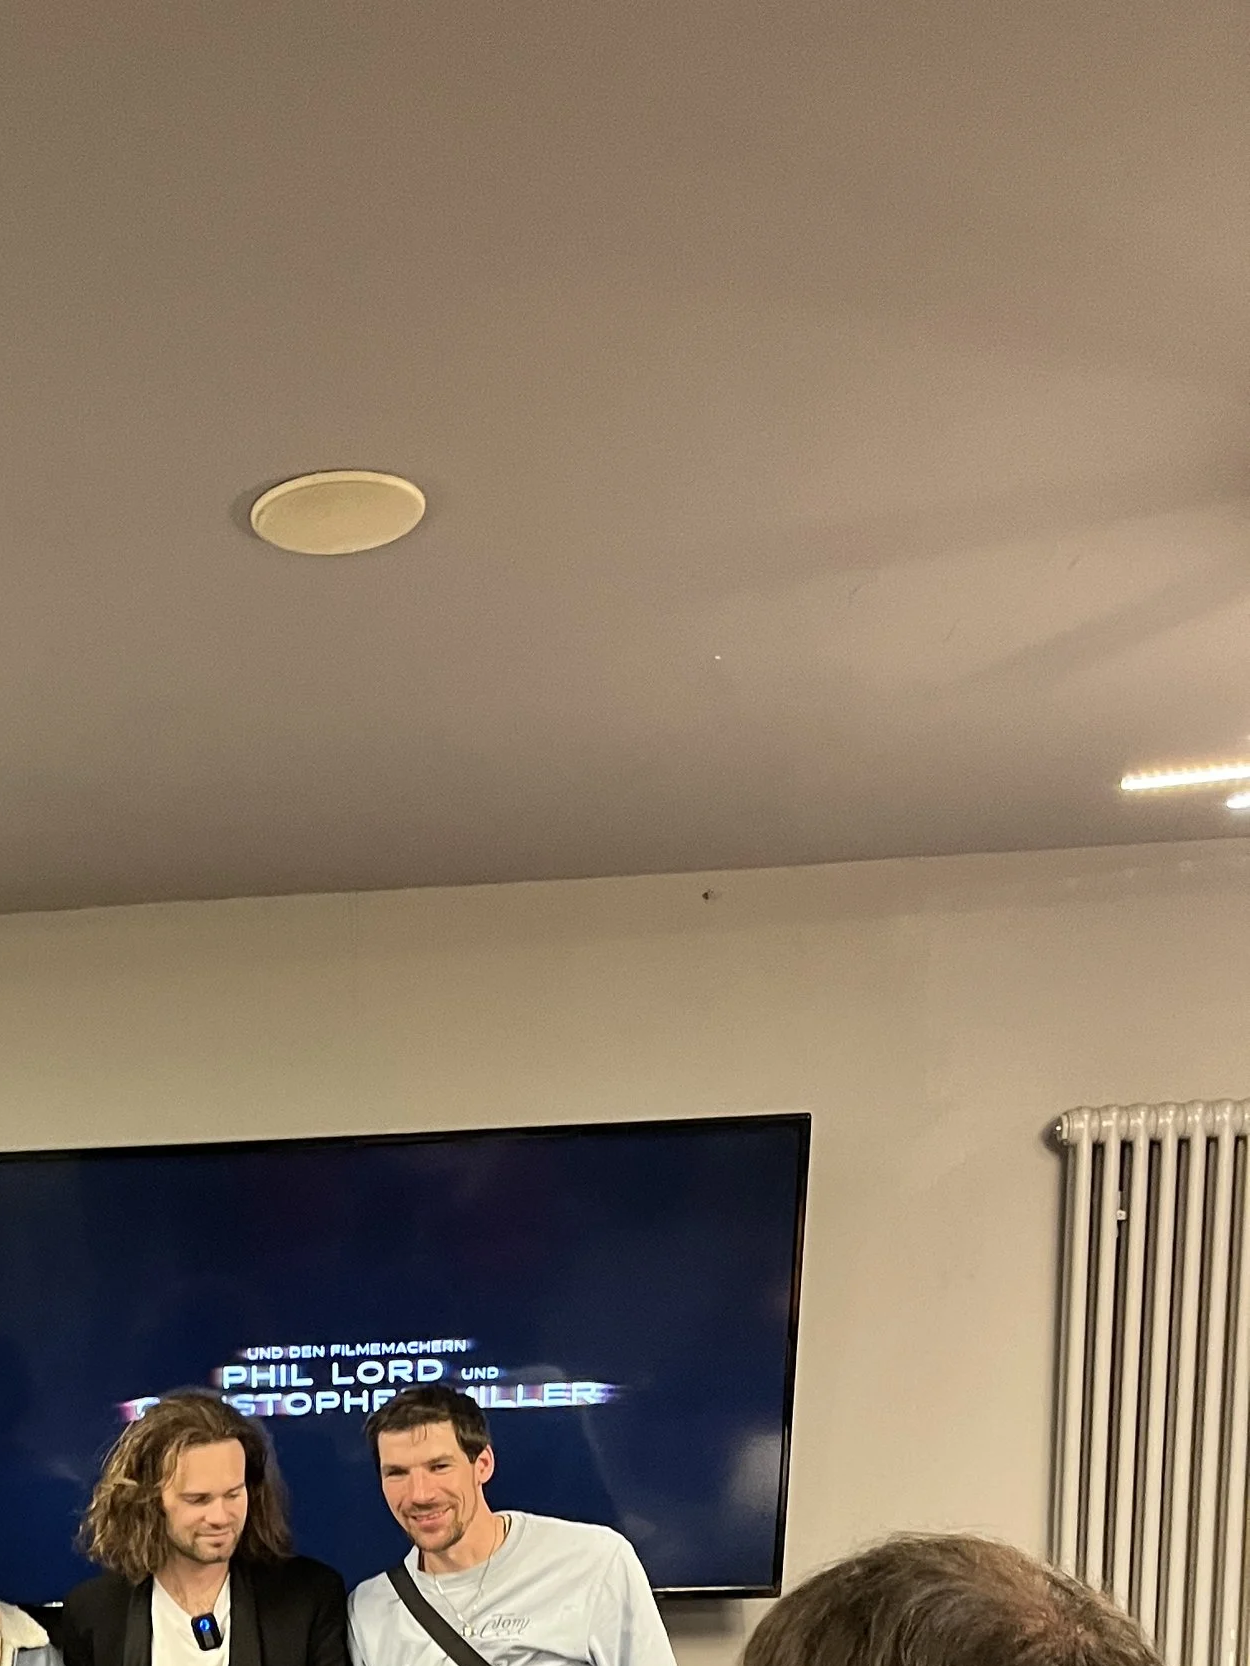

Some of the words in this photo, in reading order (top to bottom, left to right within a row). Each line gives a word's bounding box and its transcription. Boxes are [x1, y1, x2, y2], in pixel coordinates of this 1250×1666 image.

[246, 1346, 283, 1360] UND
[289, 1345, 324, 1359] DEN
[330, 1339, 467, 1357] FILMEMACHERN
[222, 1363, 313, 1389] PHIL
[332, 1358, 444, 1386] LORD
[461, 1366, 499, 1380] UND
